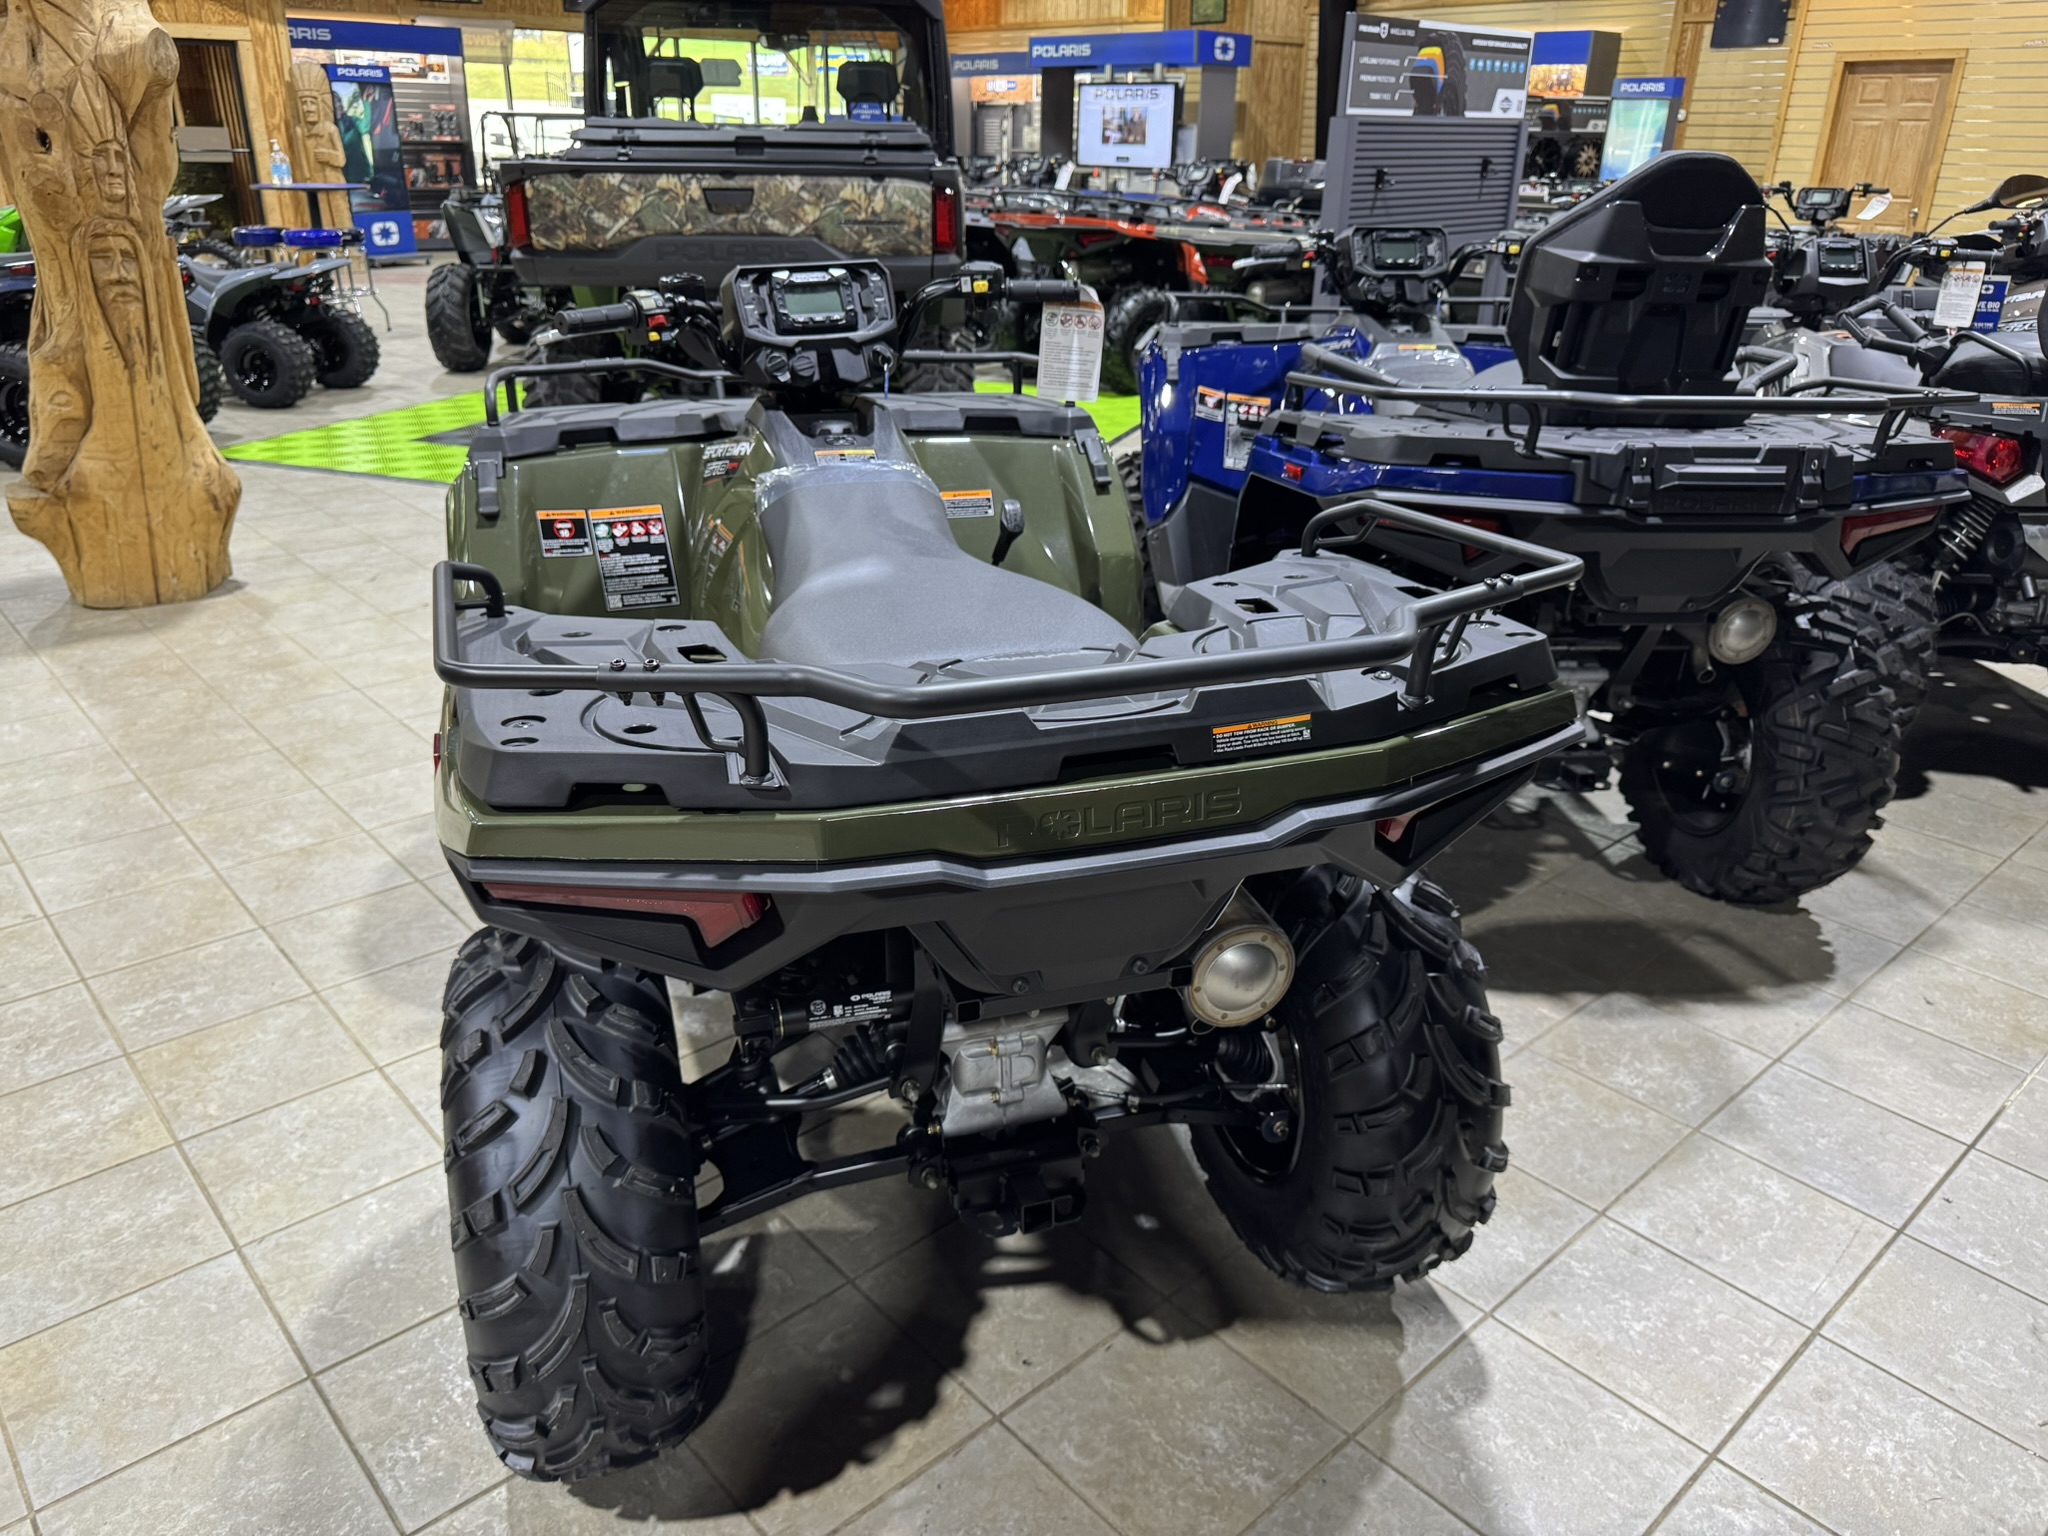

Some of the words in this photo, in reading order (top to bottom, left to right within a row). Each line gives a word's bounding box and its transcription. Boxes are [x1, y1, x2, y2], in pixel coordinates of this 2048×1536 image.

[1032, 43, 1092, 59] POLARIS
[953, 59, 999, 71] POLARIS
[336, 66, 384, 78] POLARIS
[1093, 87, 1160, 100] POLARIS
[1619, 82, 1666, 93] POLARIS
[655, 241, 809, 262] POLARIS
[1253, 720, 1278, 728] WARNING
[998, 786, 1243, 848] POLARIS
